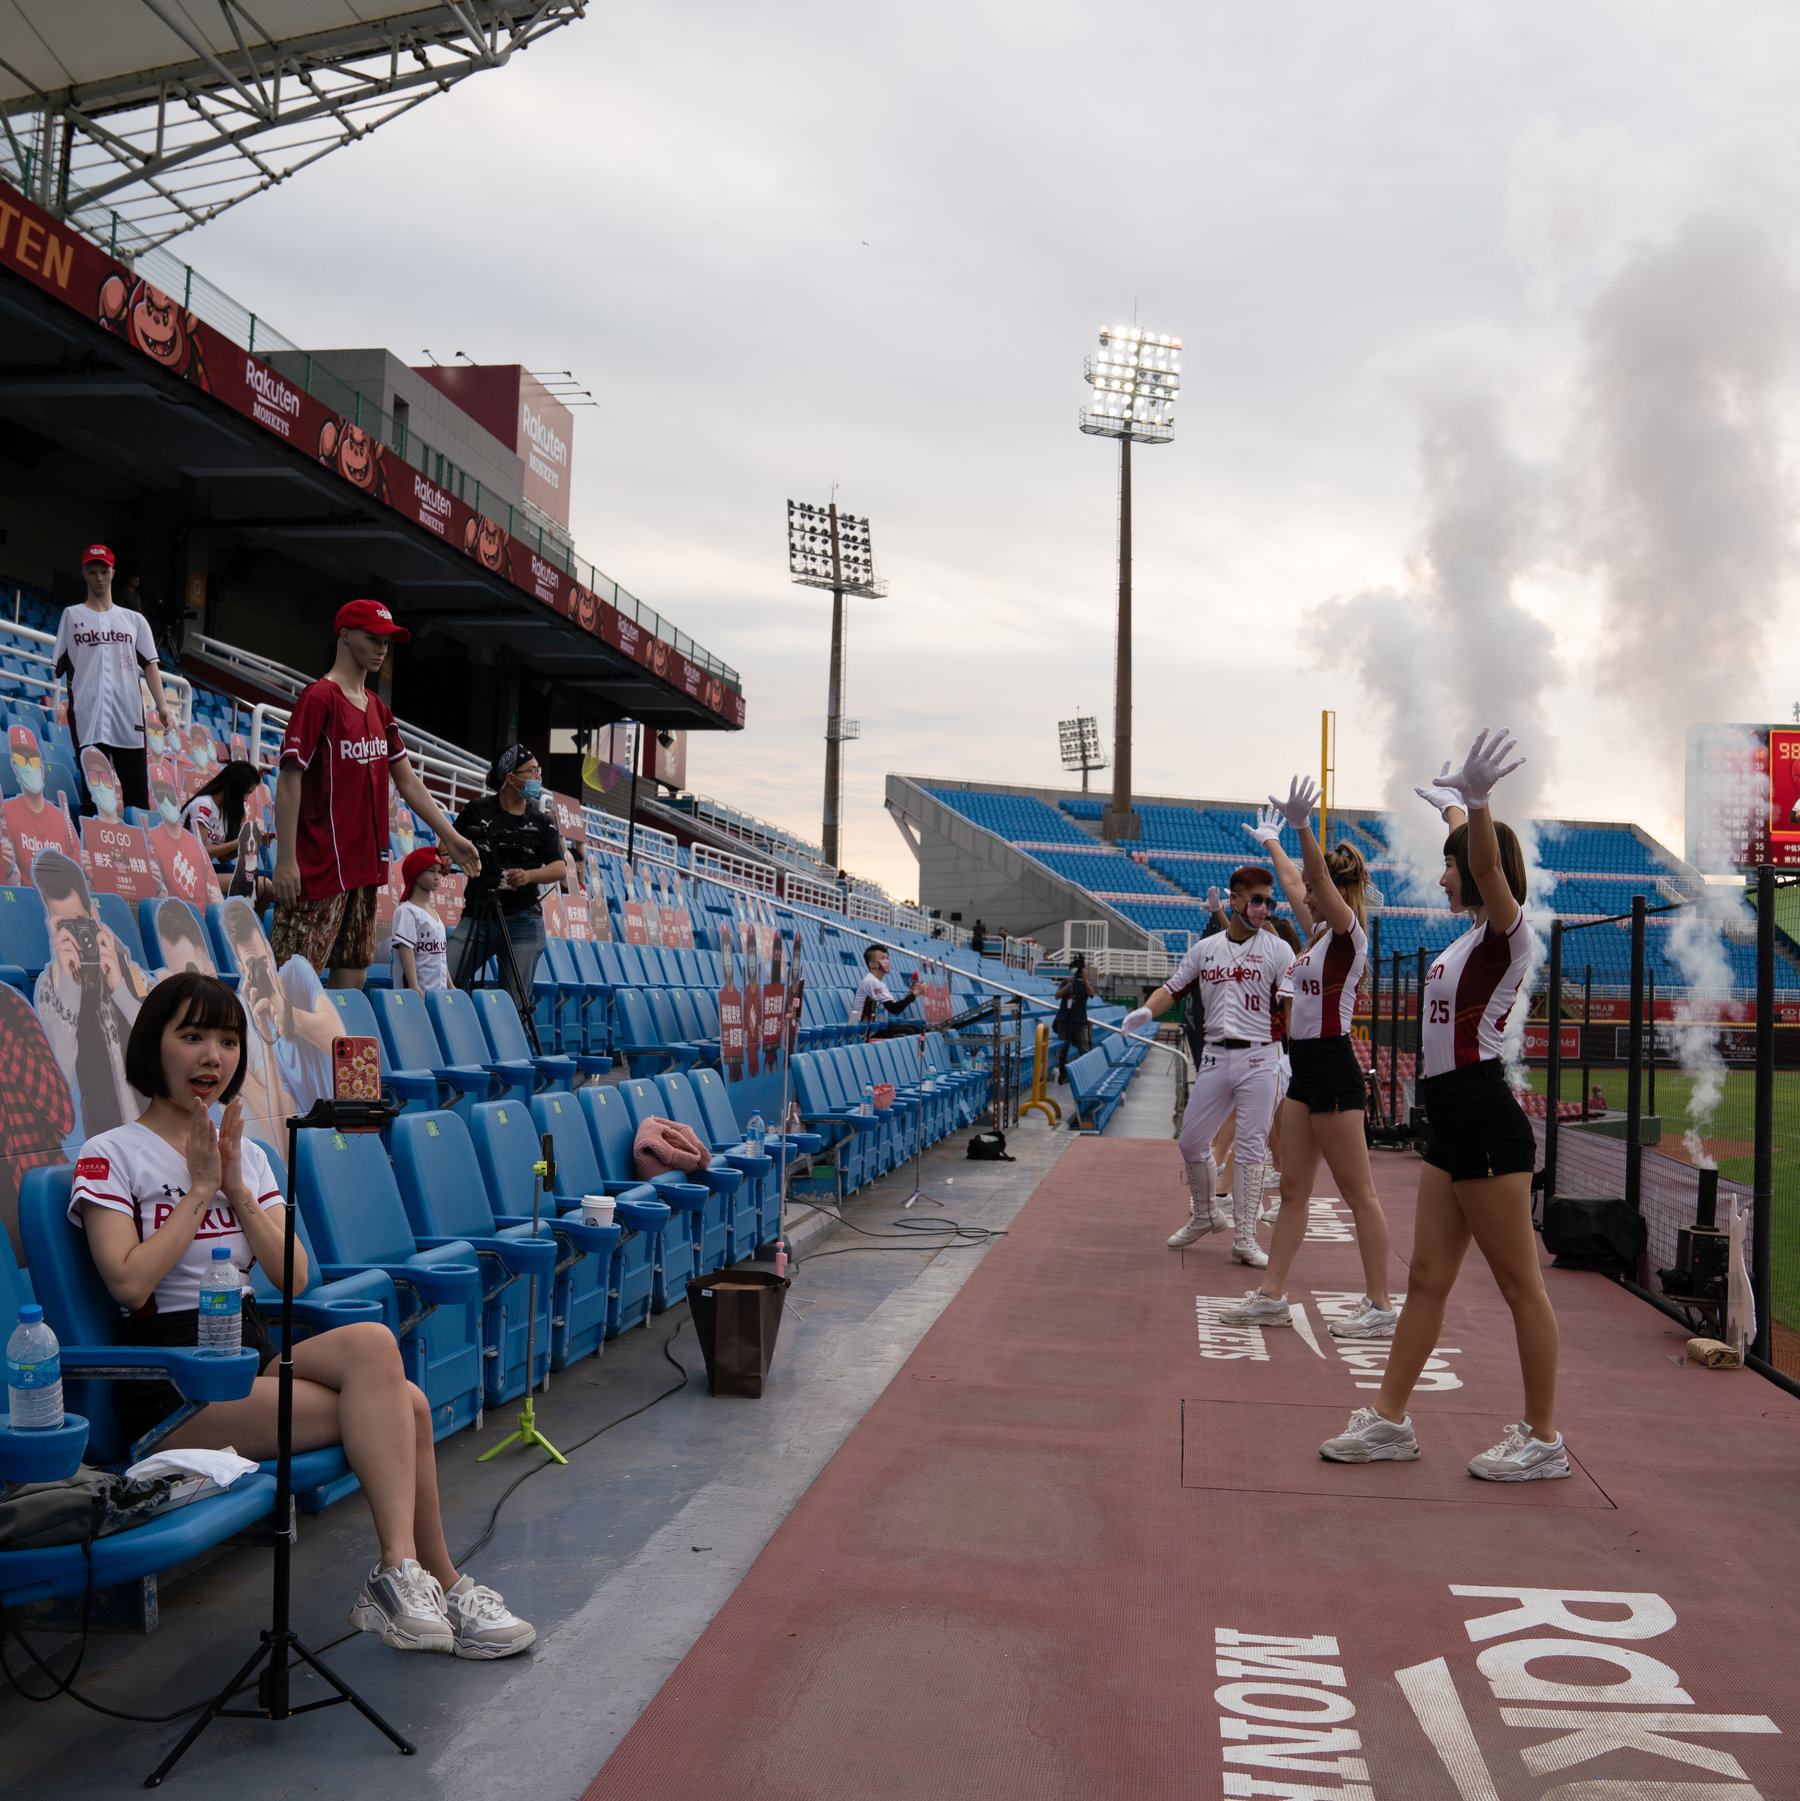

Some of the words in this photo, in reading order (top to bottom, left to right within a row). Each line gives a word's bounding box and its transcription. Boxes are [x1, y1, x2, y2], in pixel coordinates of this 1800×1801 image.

[246, 359, 300, 418] Rakuten
[253, 402, 290, 437] MONKEYS
[522, 402, 567, 468] Rakuten
[529, 452, 559, 489] MONKEYS
[414, 474, 452, 518] Rakuten
[419, 509, 445, 535] MONKEYS
[531, 555, 559, 589] Rakuten
[73, 629, 133, 647] Rakuten
[101, 829, 115, 845] GO
[116, 832, 131, 847] GO
[1755, 831, 1764, 840] 36
[1755, 843, 1764, 851] 35
[1755, 854, 1764, 863] 32
[1200, 964, 1262, 985] Rakuen
[1302, 979, 1321, 996] 48
[1244, 993, 1261, 1012] 10
[1429, 999, 1450, 1024] 25
[1448, 1584, 1783, 1801] Rak
